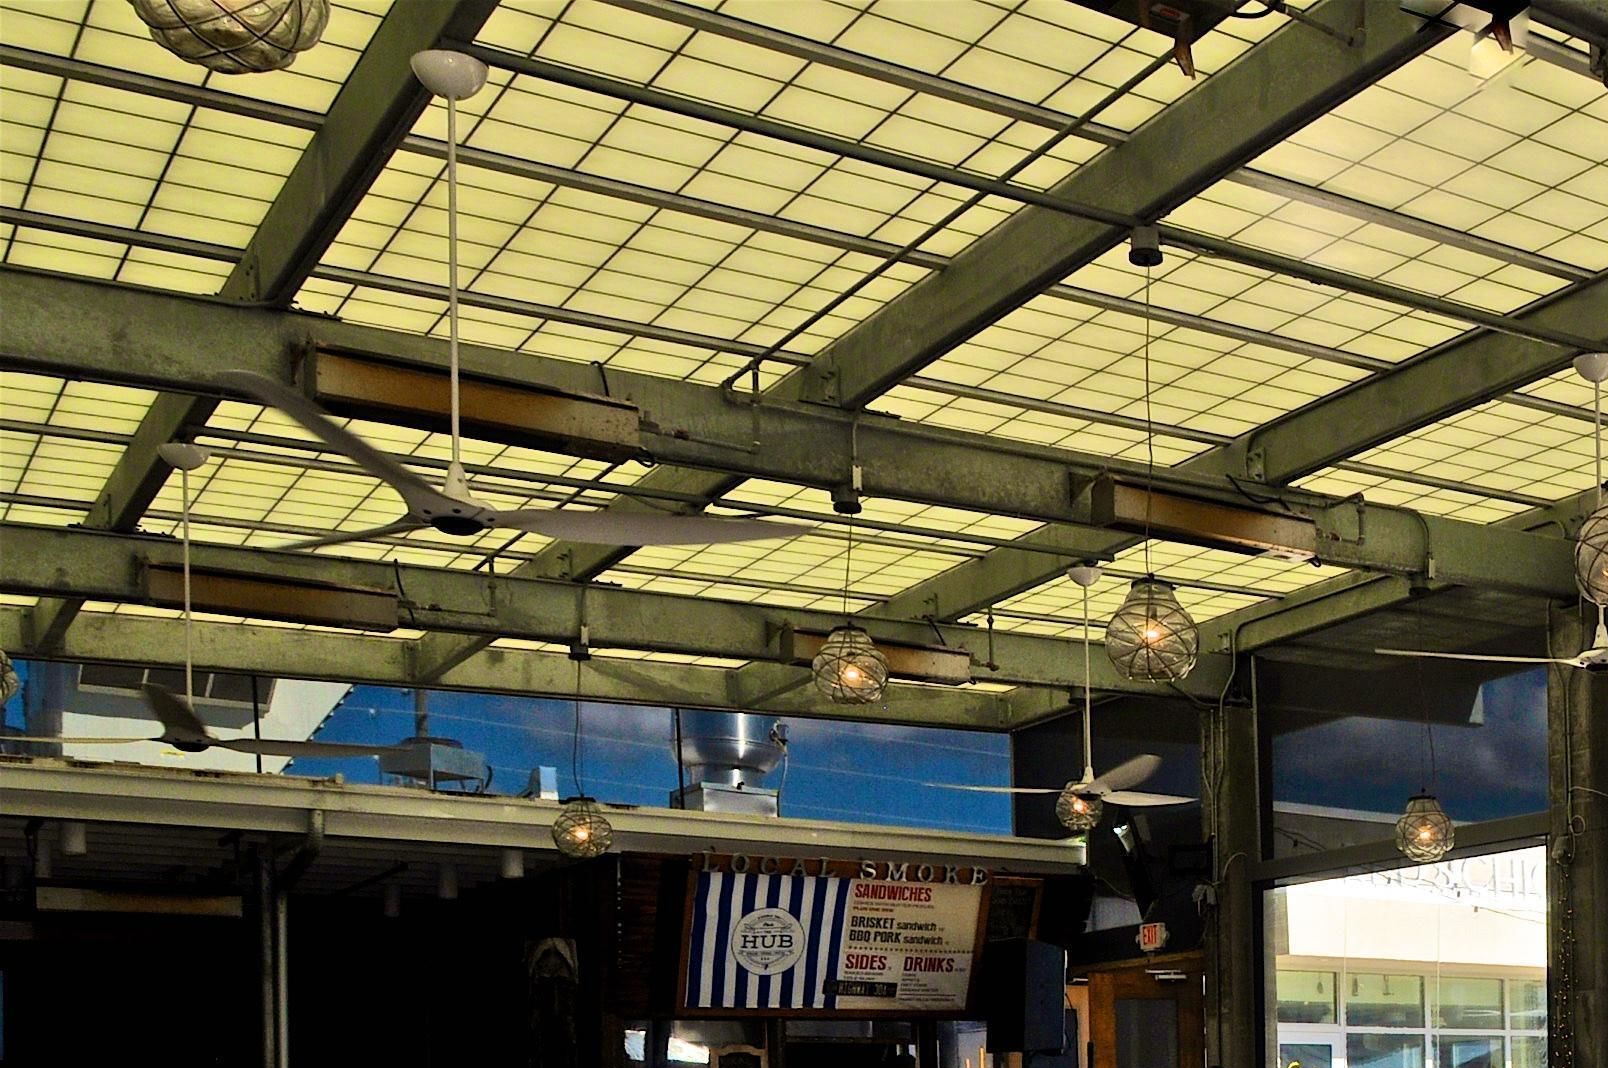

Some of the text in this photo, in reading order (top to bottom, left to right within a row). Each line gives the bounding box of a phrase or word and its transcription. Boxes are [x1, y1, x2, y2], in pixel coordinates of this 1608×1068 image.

[702, 850, 990, 886] LOCAL SMOKE
[855, 883, 932, 902] SANDWICHES
[851, 915, 937, 932] BRISKET sandwich
[741, 934, 793, 949] HUB
[849, 929, 943, 946] BBQ PORK sandwich
[845, 954, 887, 971] SIDES
[903, 956, 955, 972] DRINKS
